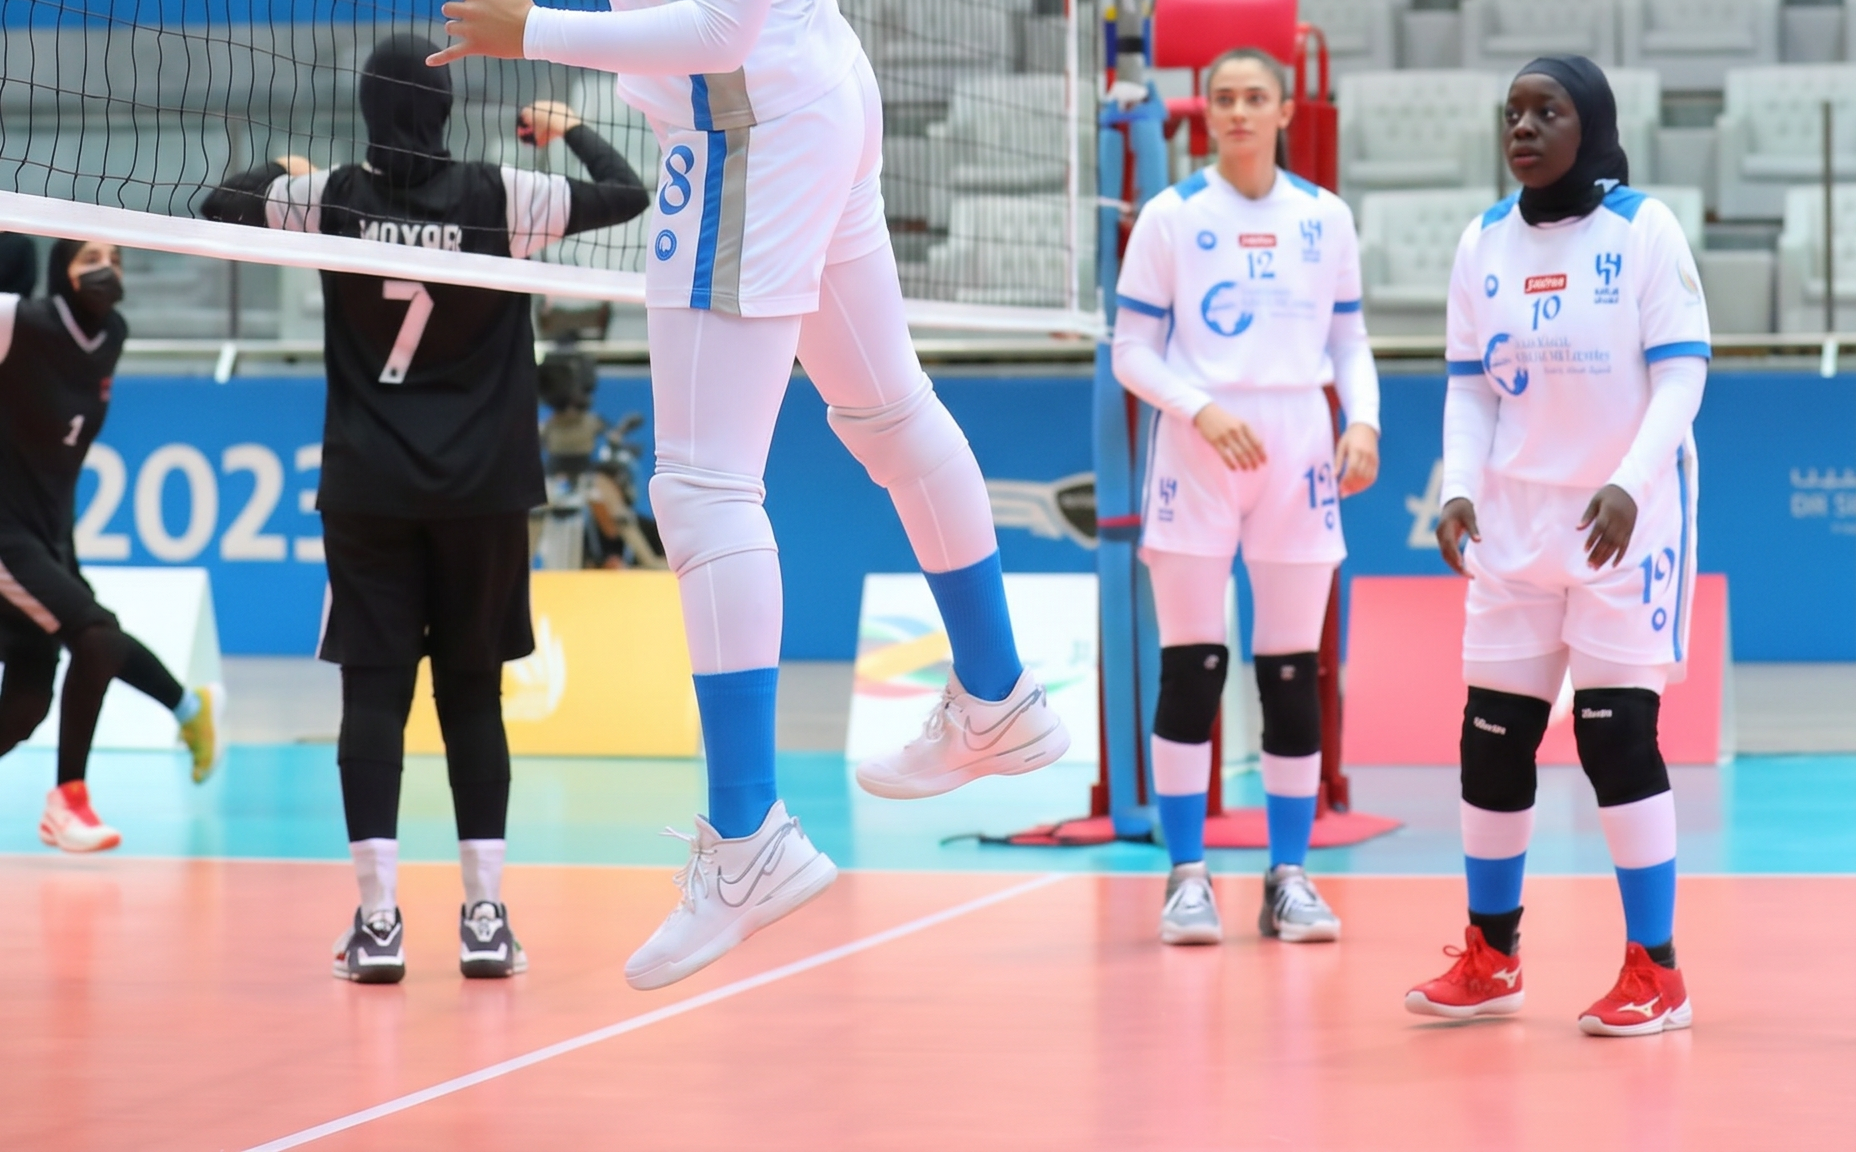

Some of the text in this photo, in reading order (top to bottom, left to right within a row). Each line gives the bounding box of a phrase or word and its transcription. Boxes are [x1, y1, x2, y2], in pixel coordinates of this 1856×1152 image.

[659, 144, 695, 216] 8
[1248, 250, 1275, 279] 12
[378, 279, 435, 384] 7
[1531, 294, 1562, 331] 10
[62, 413, 85, 446] 1
[1304, 462, 1335, 509] 12
